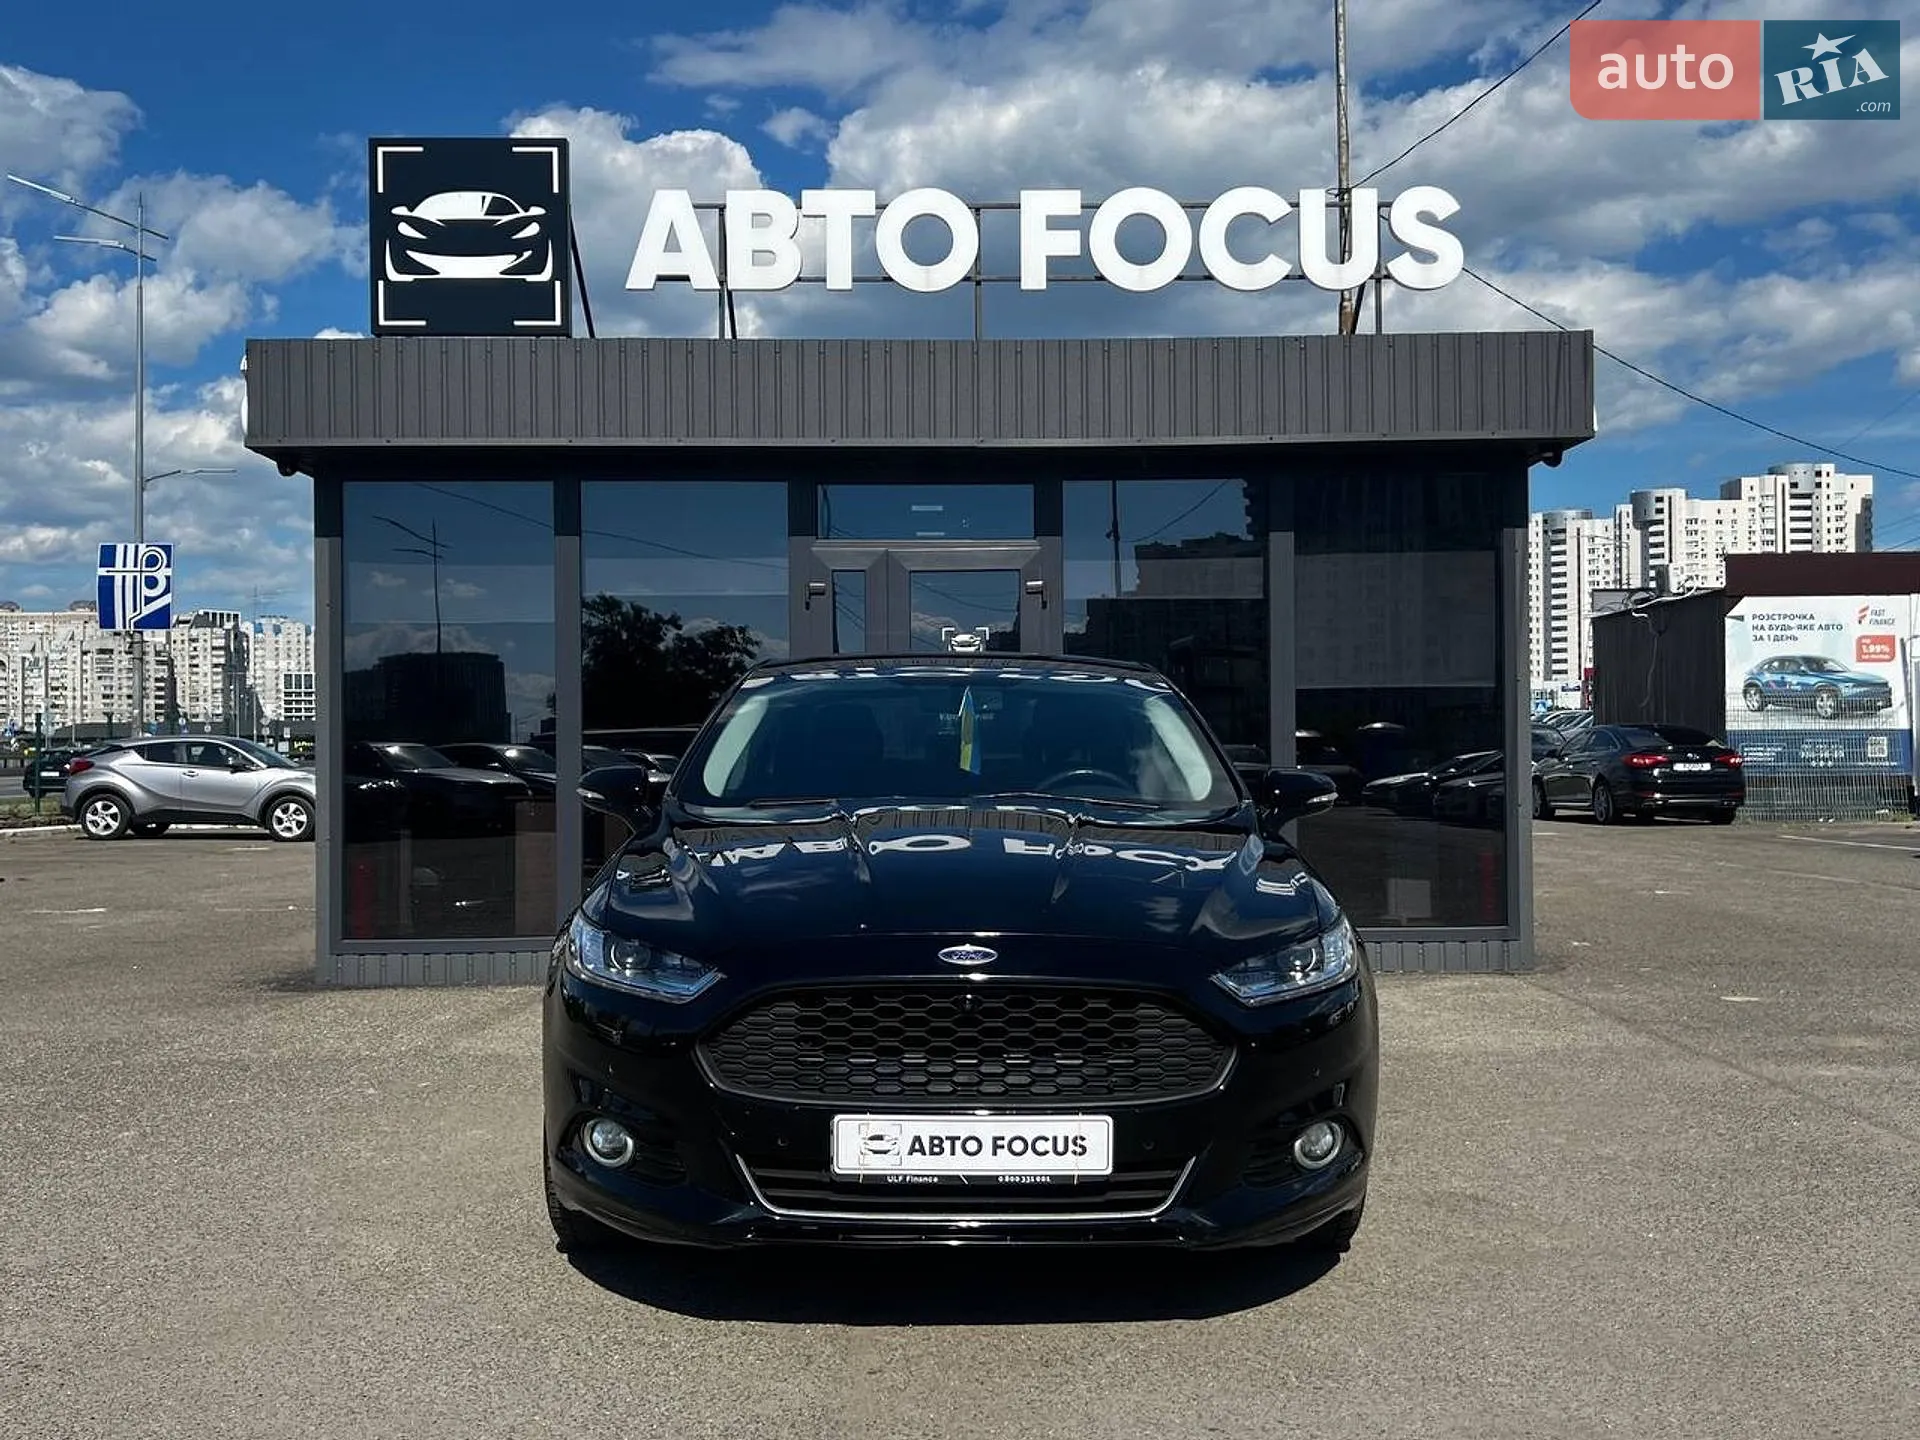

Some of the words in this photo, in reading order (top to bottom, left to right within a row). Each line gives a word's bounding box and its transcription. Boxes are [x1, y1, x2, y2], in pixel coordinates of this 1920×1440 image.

[625, 188, 980, 291] АВТО
[1020, 185, 1465, 292] FOCUS
[1751, 613, 1815, 621] РОЗСТРОЧКА
[1751, 623, 1766, 632] НА
[1816, 623, 1844, 632] АВТО
[1751, 634, 1765, 642] ЗА
[1772, 634, 1799, 643] ДЕНЬ
[907, 1135, 984, 1157] АВТО
[991, 1135, 1088, 1157] FOCUS
